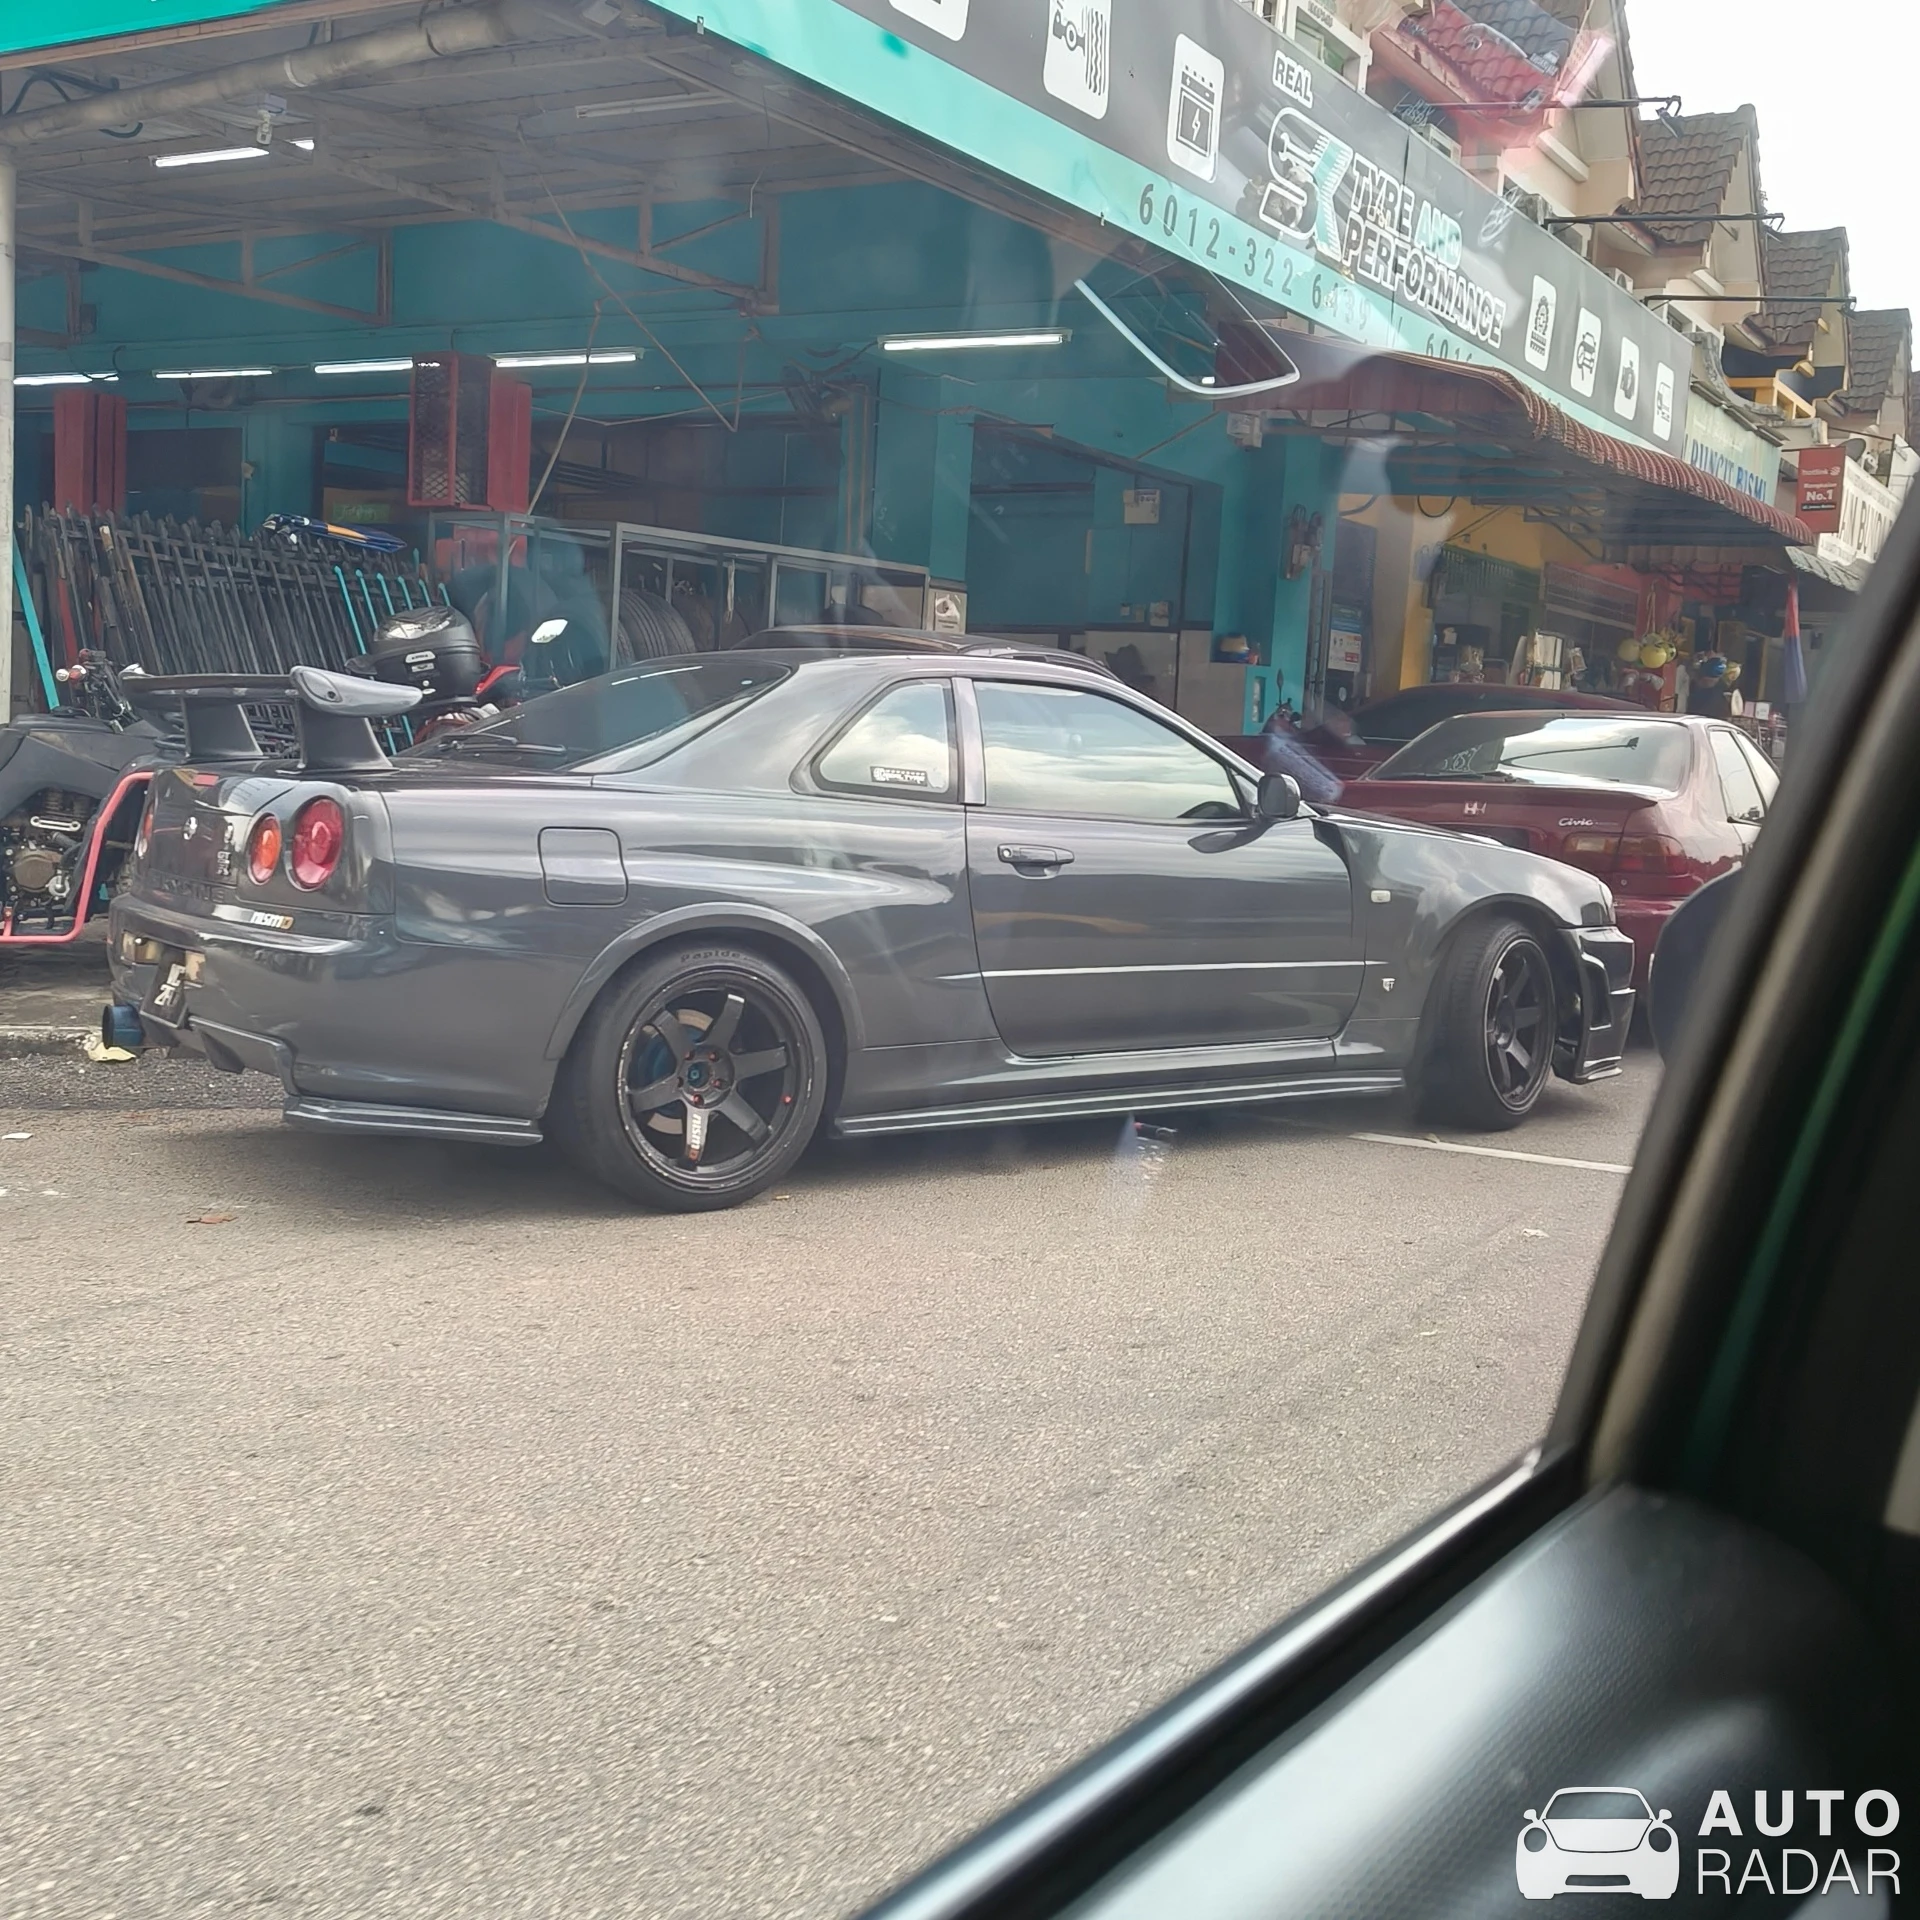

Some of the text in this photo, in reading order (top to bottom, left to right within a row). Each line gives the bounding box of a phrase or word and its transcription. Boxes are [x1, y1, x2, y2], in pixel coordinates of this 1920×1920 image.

[1273, 50, 1313, 109] REAL
[1352, 152, 1463, 270] TYRE AND
[1342, 211, 1506, 348] PERFORMANCE
[1806, 489, 1834, 501] No.1
[1558, 817, 1593, 827] Civic
